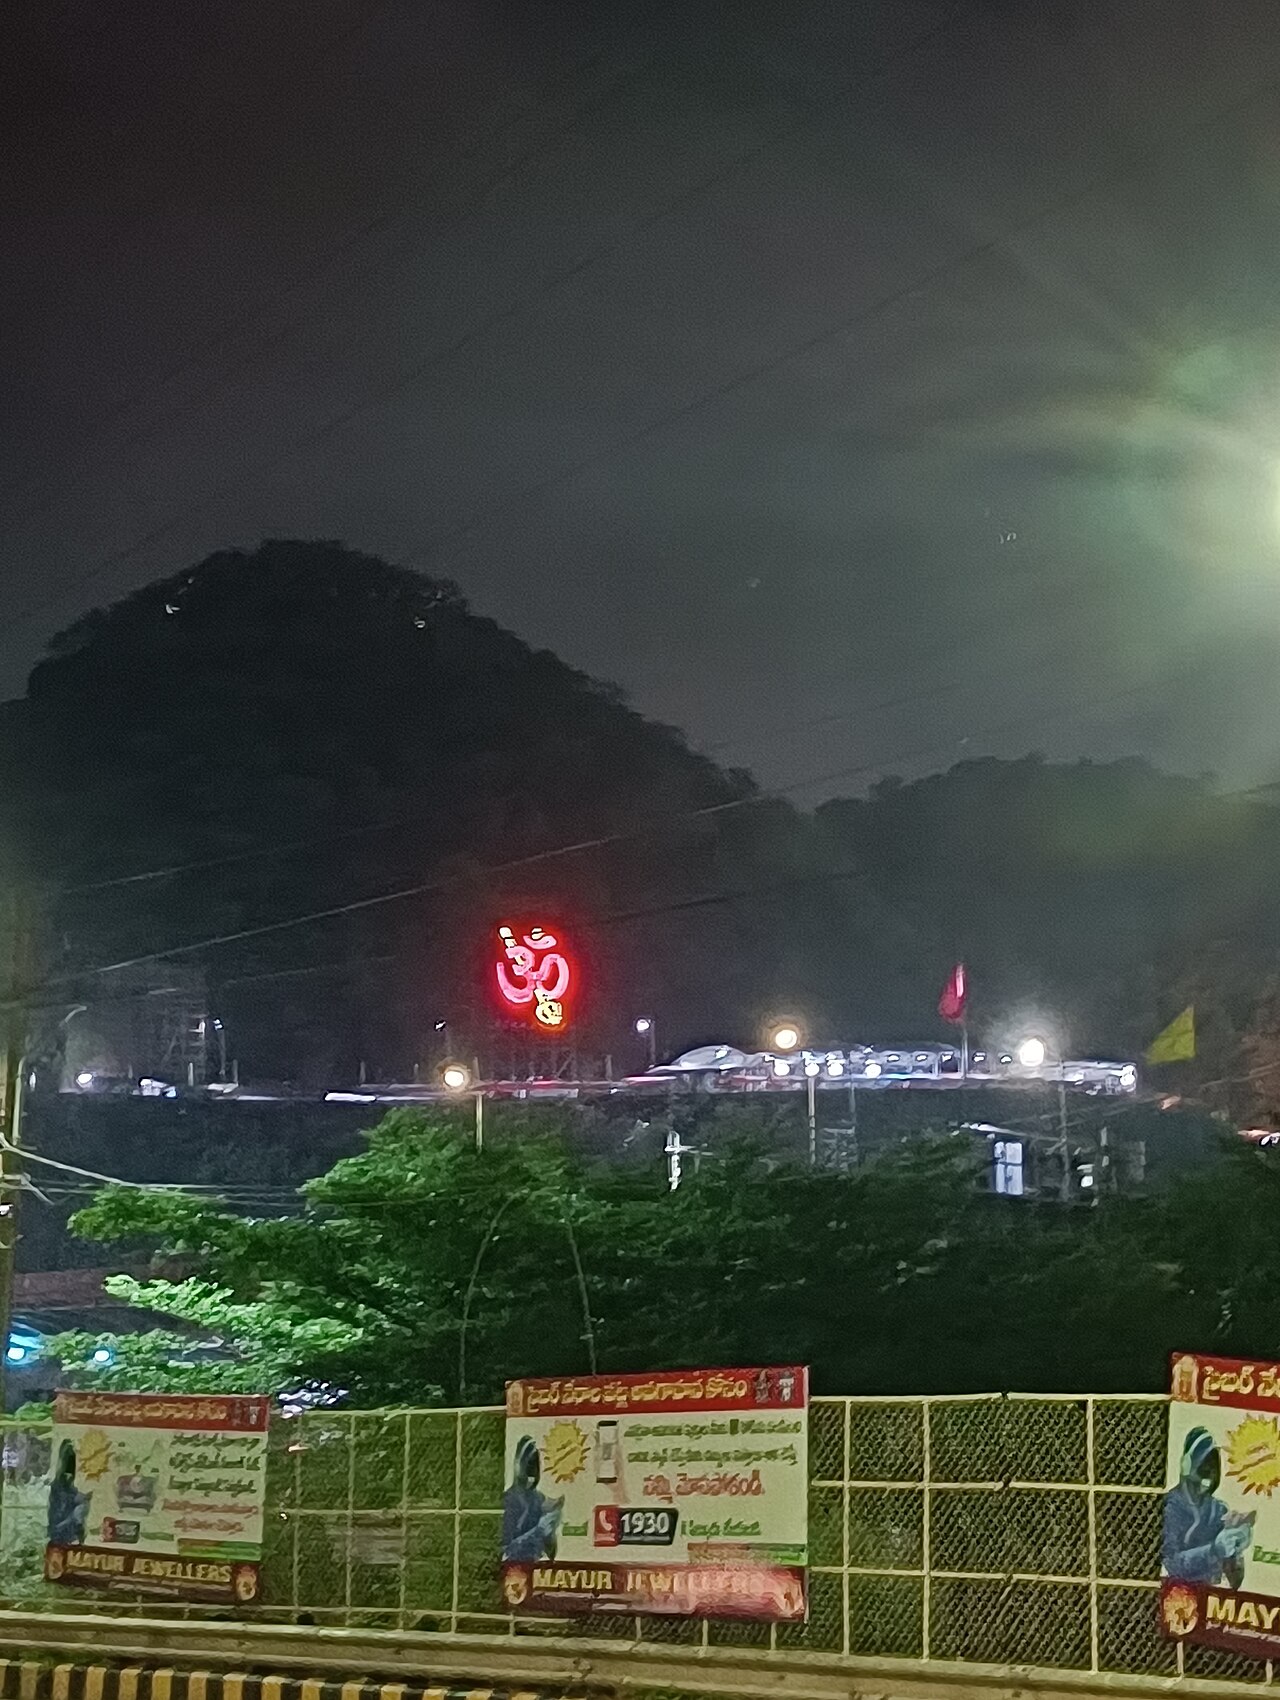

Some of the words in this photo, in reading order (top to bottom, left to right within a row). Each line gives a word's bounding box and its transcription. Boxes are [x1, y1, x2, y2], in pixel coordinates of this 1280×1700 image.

[621, 1512, 669, 1535] 1930
[67, 1550, 125, 1572] MAYUR
[533, 1568, 612, 1591] MAYUR
[1206, 1595, 1280, 1630] MAY
